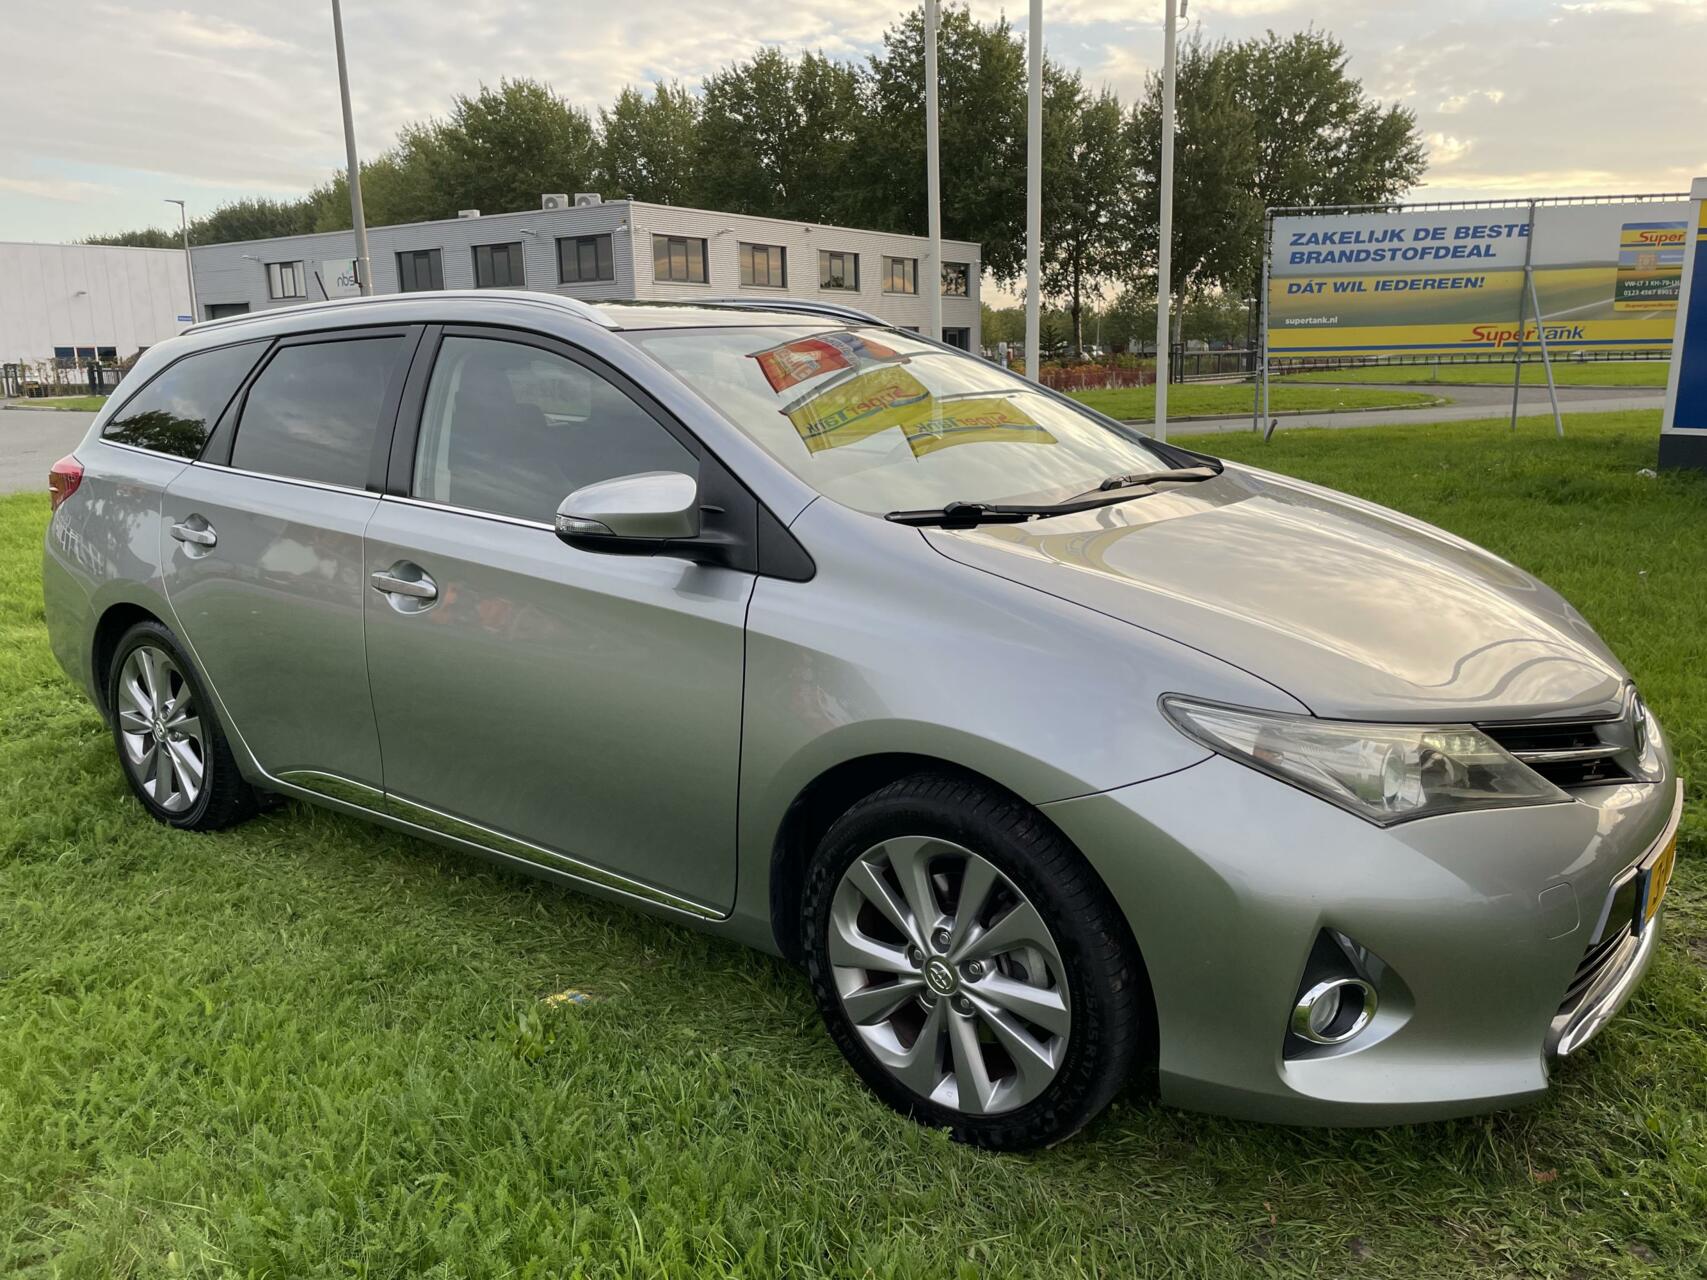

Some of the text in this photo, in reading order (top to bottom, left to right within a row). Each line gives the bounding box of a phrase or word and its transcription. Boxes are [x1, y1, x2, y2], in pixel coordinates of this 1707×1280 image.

[1289, 223, 1533, 246] ZAKELIJK DE BESTE
[1289, 244, 1496, 264] BRANDSTOFDEAL
[1287, 277, 1485, 294] DÁT WIL IEDEREEN!
[1285, 316, 1338, 326] supertank.nl
[1461, 325, 1585, 348] SuperTank
